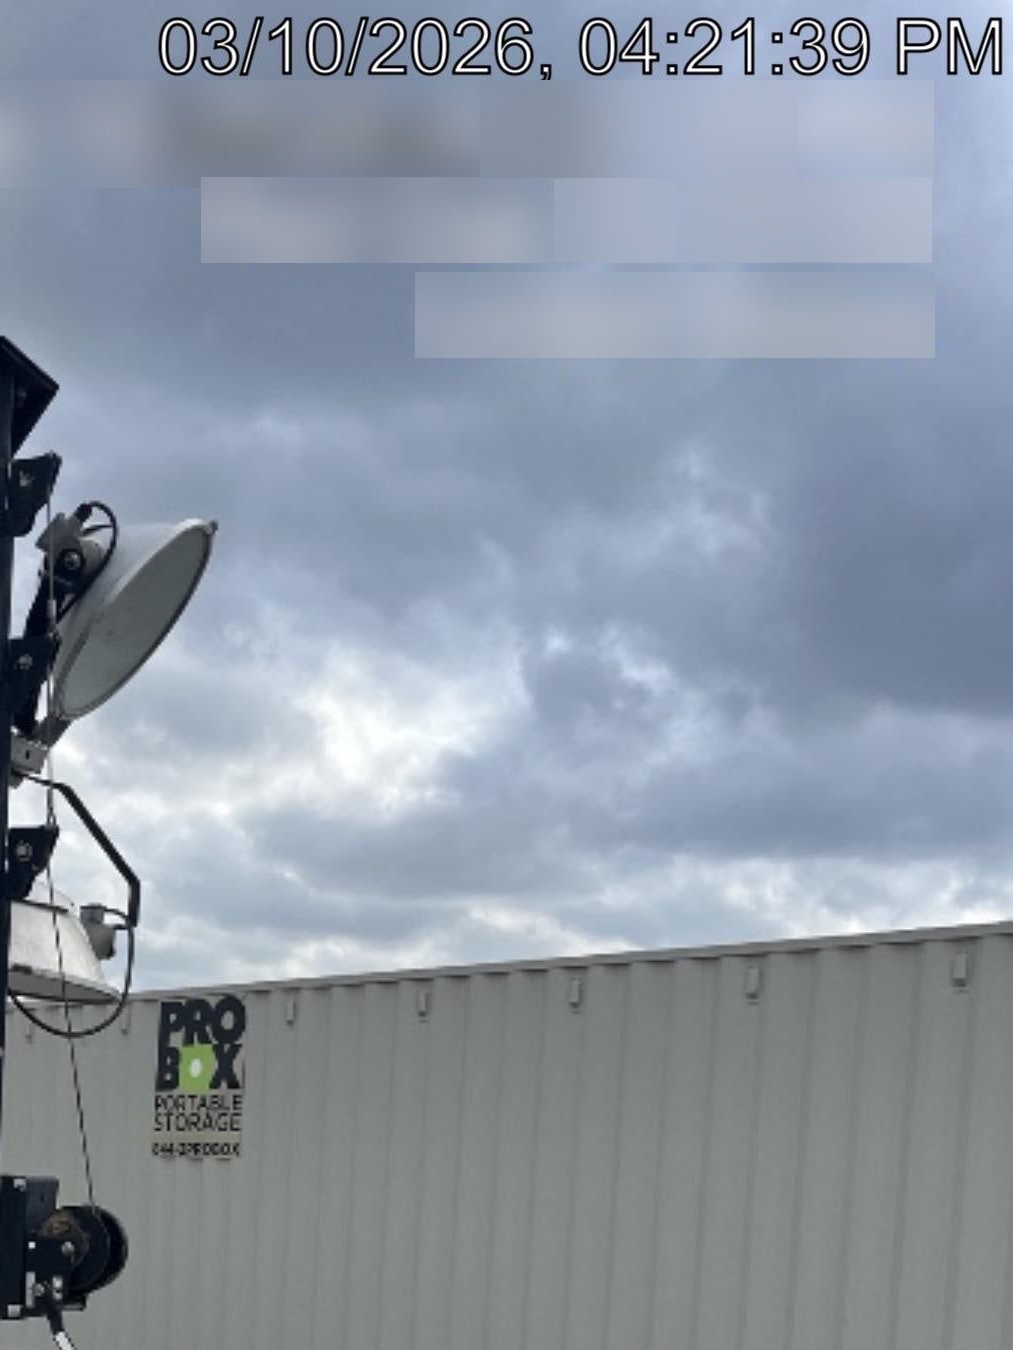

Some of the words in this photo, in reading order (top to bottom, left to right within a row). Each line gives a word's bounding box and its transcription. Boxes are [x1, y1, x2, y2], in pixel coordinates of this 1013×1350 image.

[158, 994, 246, 1047] PRO
[155, 1043, 243, 1092] BOX
[155, 1094, 243, 1111] PORTABLE
[154, 1112, 243, 1132] STORAGE
